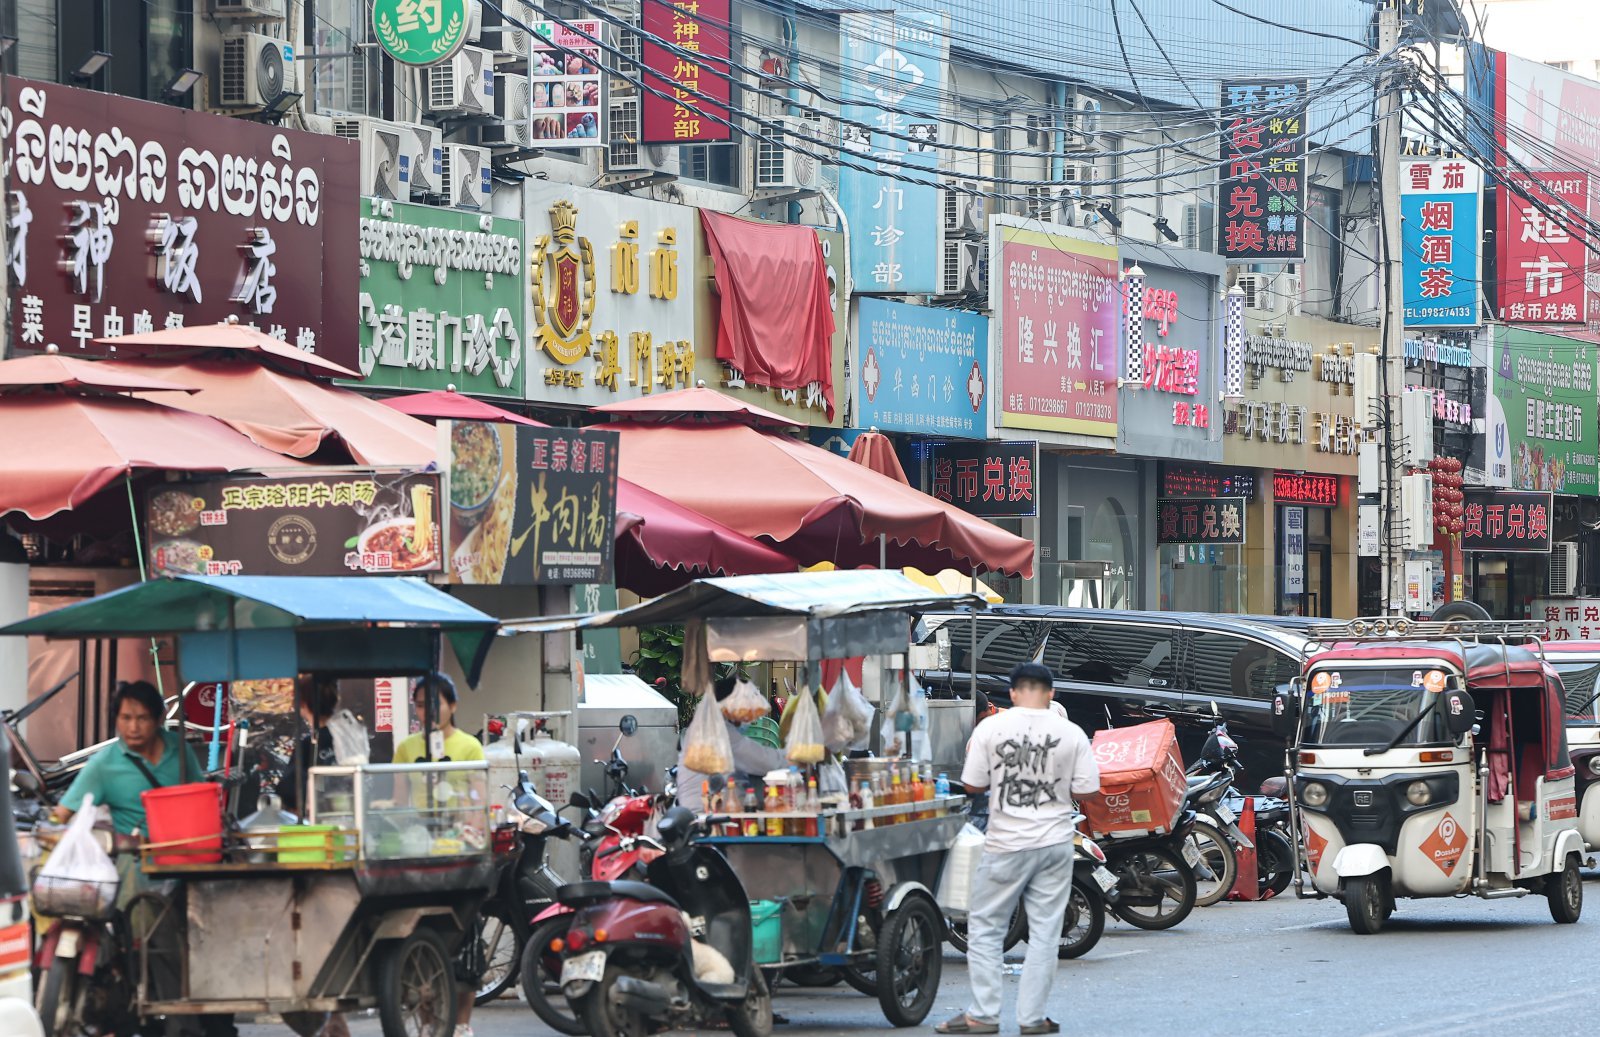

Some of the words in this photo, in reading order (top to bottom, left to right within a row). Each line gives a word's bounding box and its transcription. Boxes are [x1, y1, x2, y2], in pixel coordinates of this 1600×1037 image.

[1225, 117, 1265, 252] 货币兑换
[1267, 177, 1298, 192] ABA
[1409, 162, 1466, 191] 雪茄
[1266, 215, 1297, 233] 微信
[1266, 234, 1297, 252] 支付宝
[1420, 201, 1454, 299] 烟酒茶
[1520, 204, 1571, 298] 超市
[1509, 302, 1578, 321] 货币兑换
[378, 303, 492, 376] 益康门诊
[1018, 315, 1104, 371] 隆兴换汇
[1088, 380, 1105, 397] 人民币
[532, 437, 606, 474] 正宗洛阳
[931, 455, 1033, 502] 货币兑换
[1161, 503, 1241, 539] 货币兑换
[1464, 502, 1548, 540] 货币兑换
